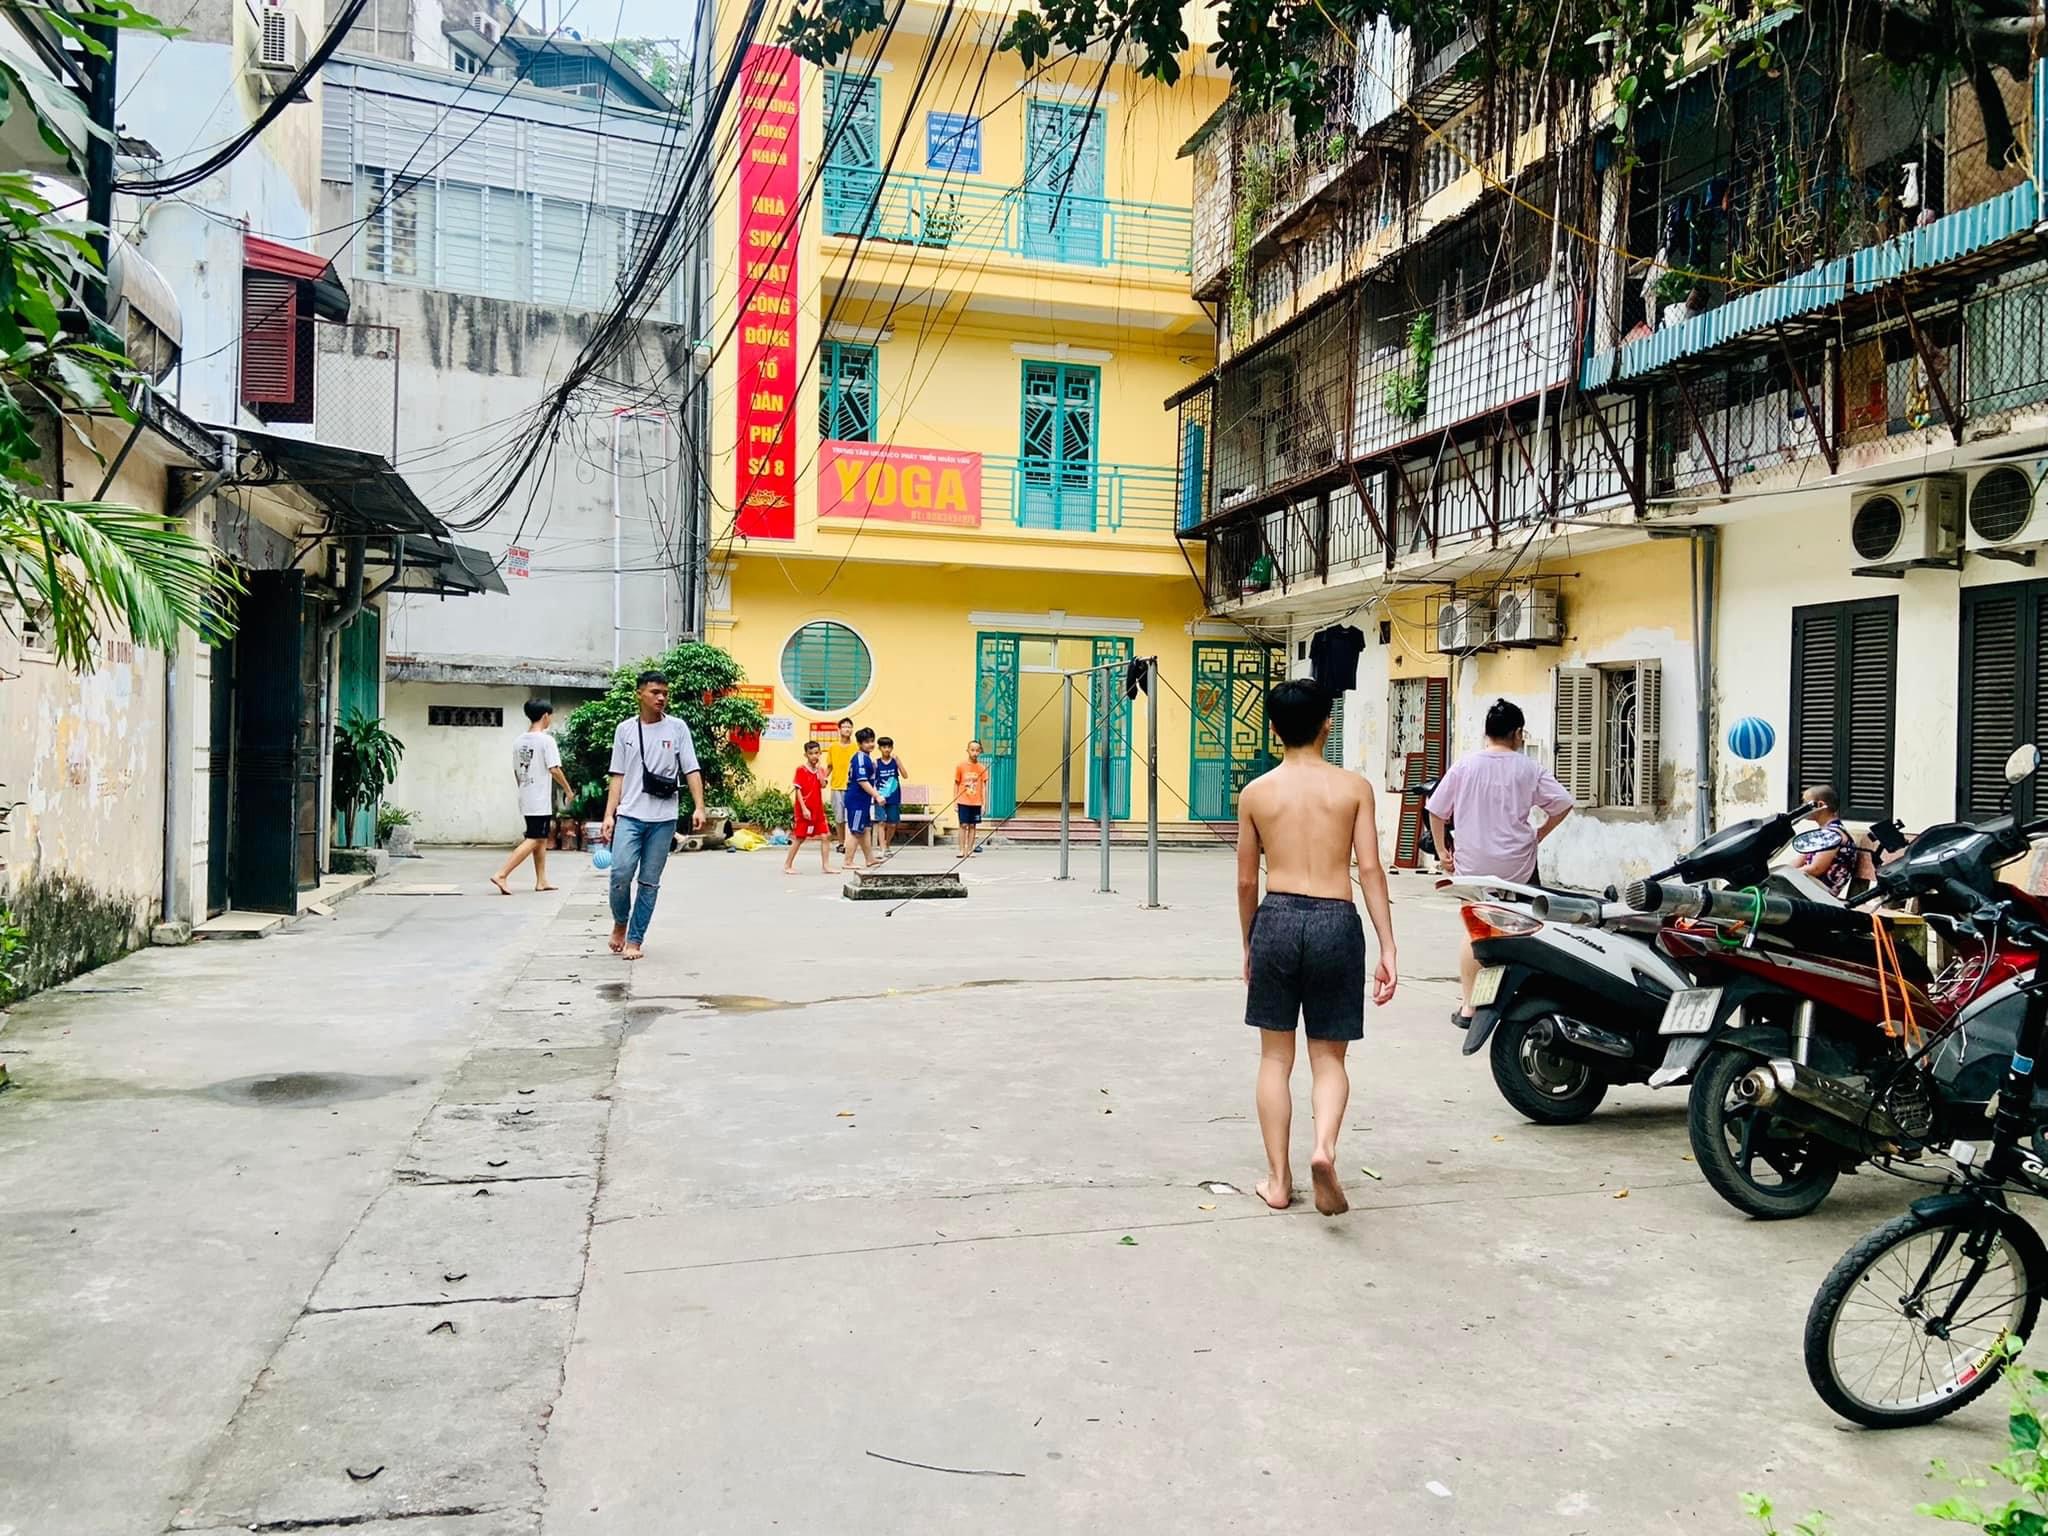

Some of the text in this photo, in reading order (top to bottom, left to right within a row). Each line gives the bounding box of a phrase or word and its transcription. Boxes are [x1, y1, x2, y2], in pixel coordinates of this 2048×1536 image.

[752, 194, 786, 216] NHÀ
[749, 229, 788, 249] SINH
[752, 390, 784, 411] DÂN
[774, 460, 785, 477] 8
[835, 457, 968, 512] YOGA
